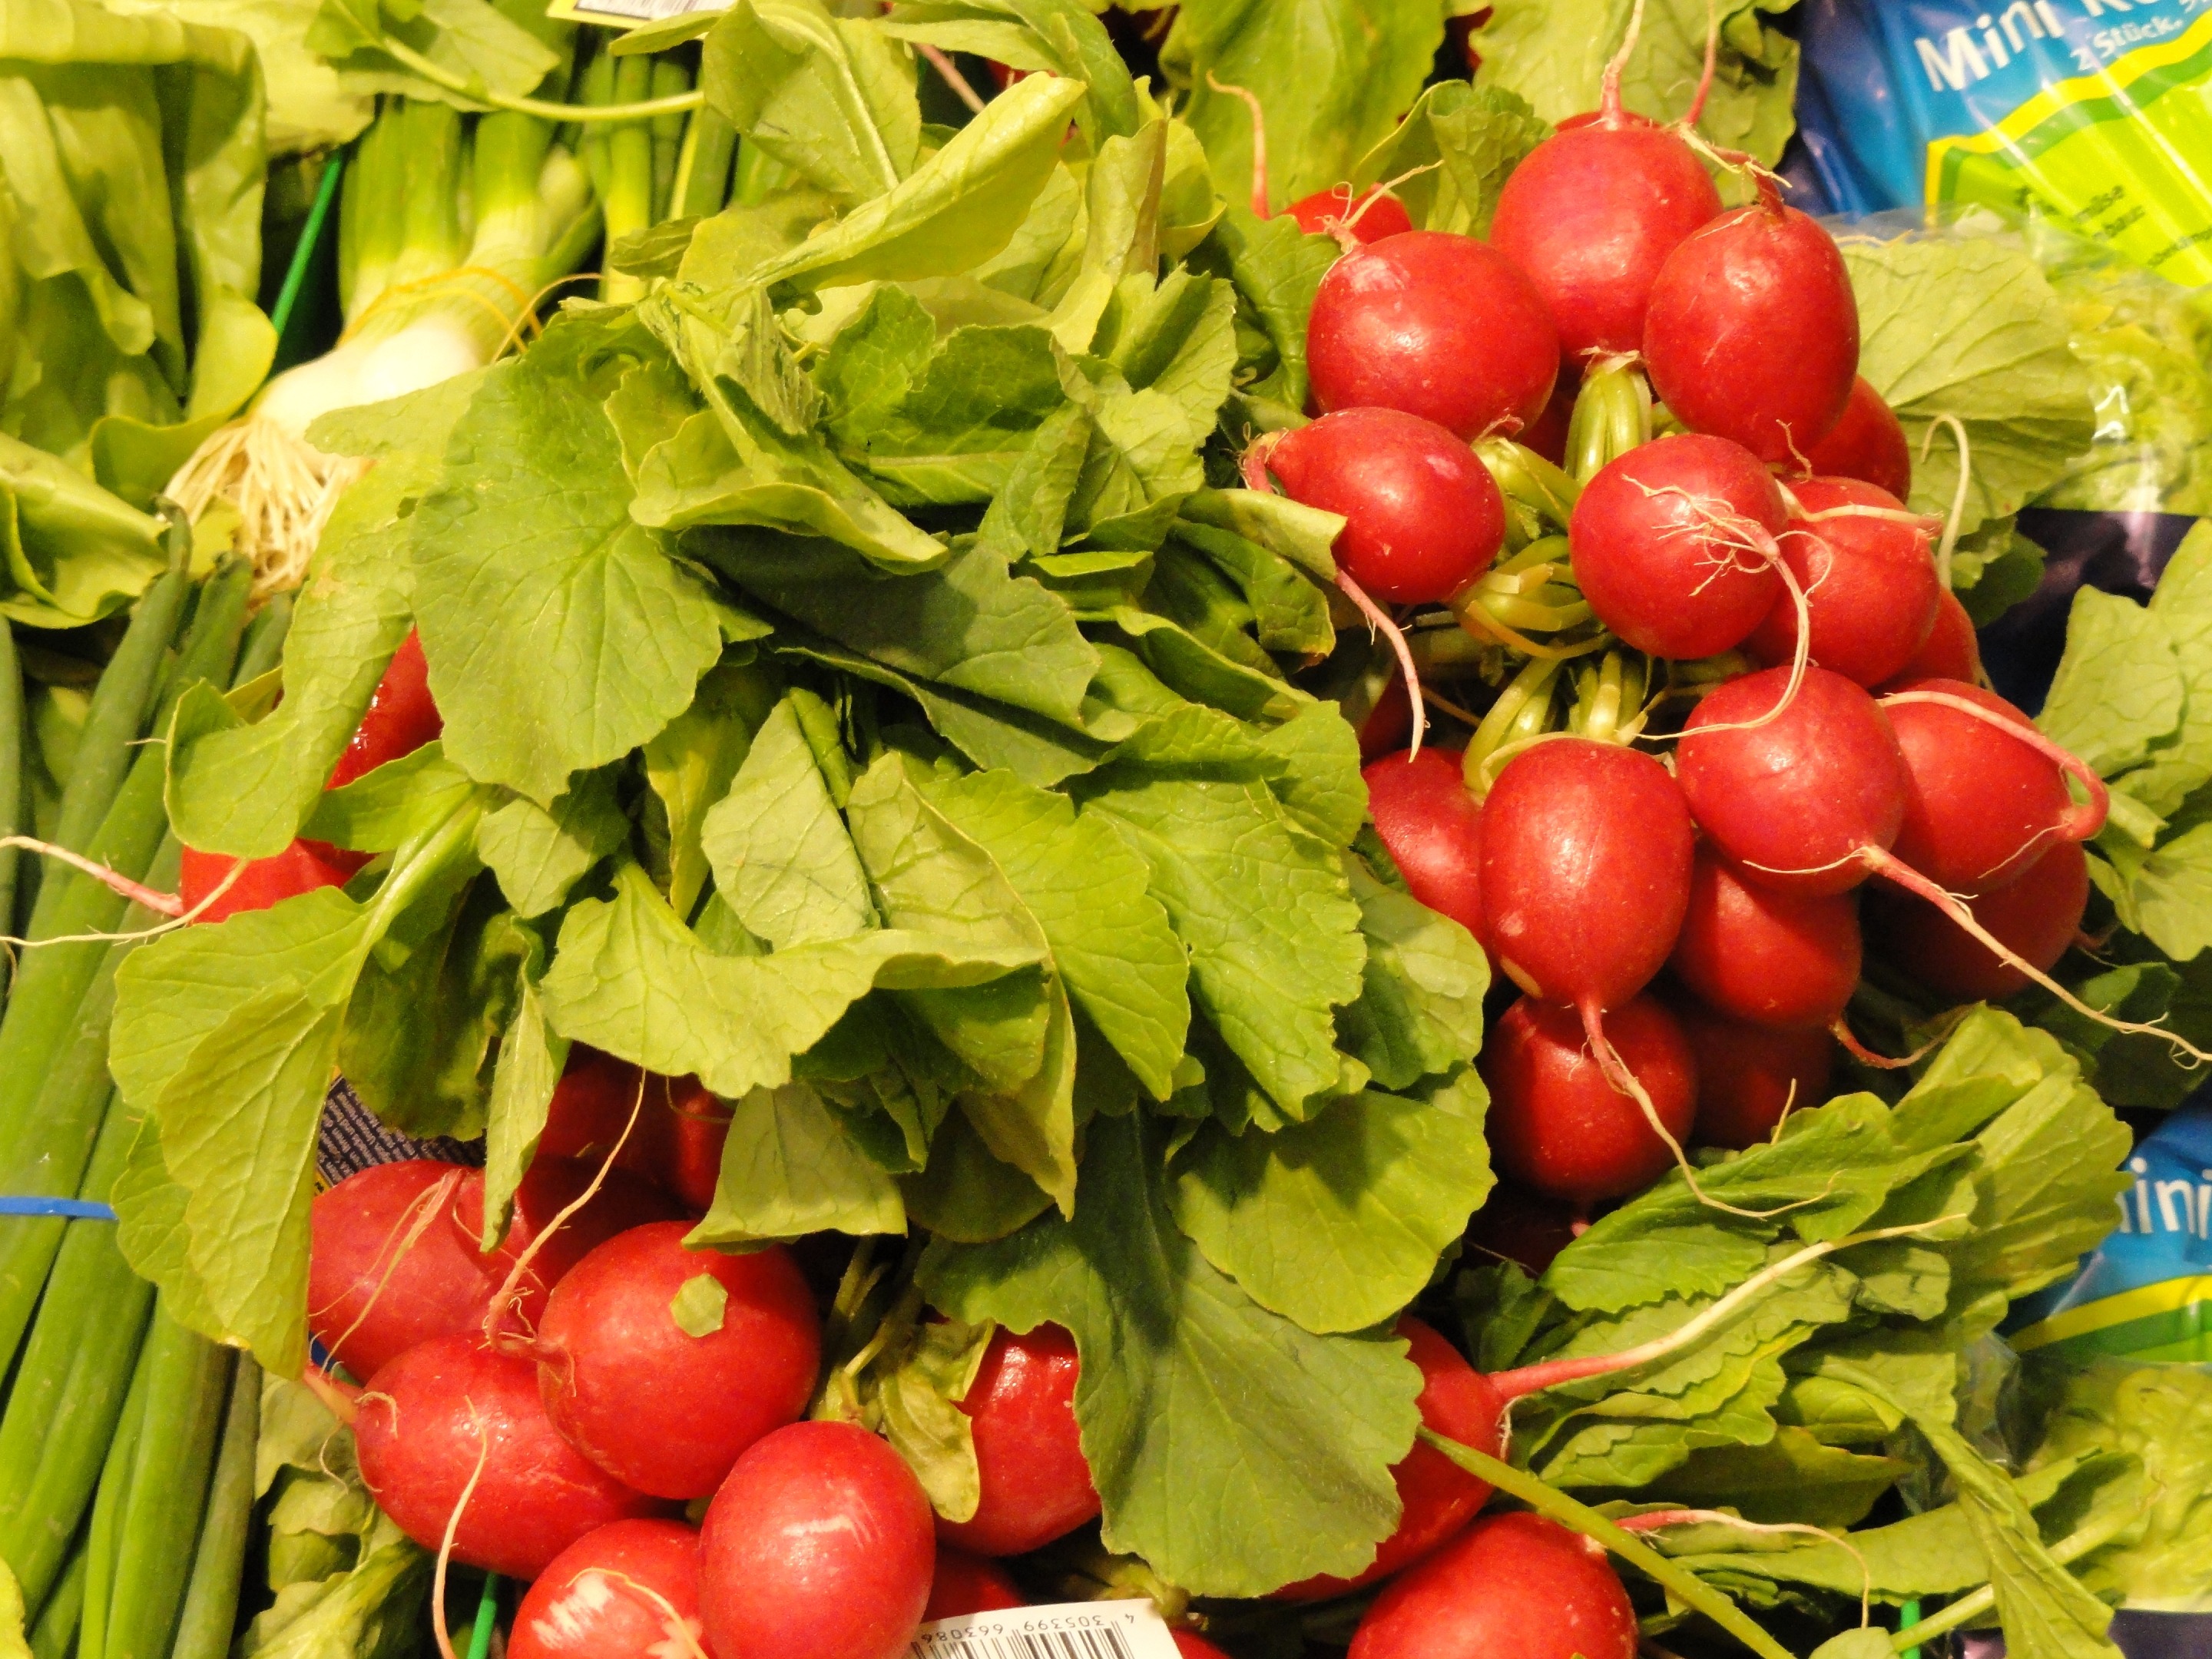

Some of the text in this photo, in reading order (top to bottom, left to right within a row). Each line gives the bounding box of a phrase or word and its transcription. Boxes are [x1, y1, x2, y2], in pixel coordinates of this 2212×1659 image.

[1914, 0, 2065, 91] Mini
[2114, 1157, 2212, 1240] ini
[921, 1613, 1134, 1644] 4 305399 663086
